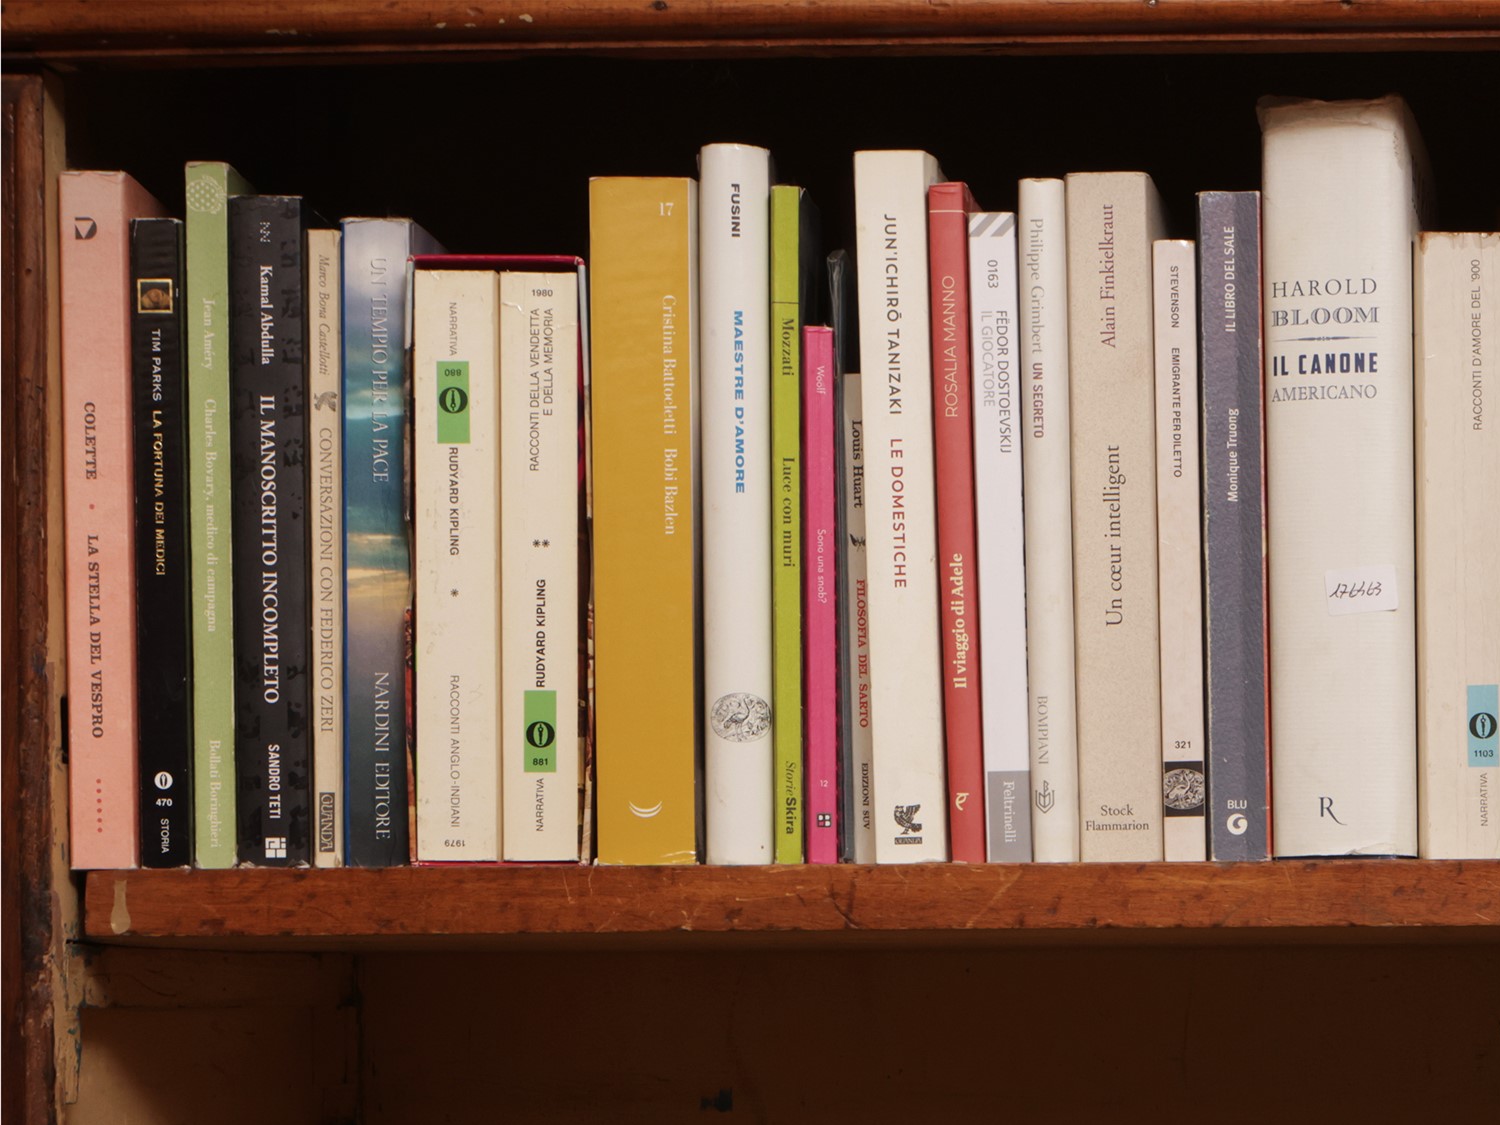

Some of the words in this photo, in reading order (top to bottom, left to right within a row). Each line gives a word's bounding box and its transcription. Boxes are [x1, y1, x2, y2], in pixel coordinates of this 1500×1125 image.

[731, 184, 740, 237] FUSINI
[260, 265, 273, 308] Kamal
[987, 260, 999, 288] 0163
[1272, 279, 1377, 298] HAROLD
[1170, 266, 1179, 328] STEVENSON
[1272, 307, 1380, 327] BLOOM
[152, 329, 161, 351] TIM
[261, 312, 273, 364] Abdulla
[663, 295, 675, 354] Cristina
[996, 311, 1010, 356] FËDOR
[735, 311, 744, 400] MAESTRE
[888, 329, 901, 414] TANIZAKI
[1172, 348, 1180, 408] EMIGRANTE
[1274, 356, 1289, 376] IL
[1299, 353, 1378, 374] CANONE
[152, 357, 162, 401] PARKS
[664, 359, 677, 434] Battocletti
[1272, 384, 1377, 402] AMERICANO
[153, 410, 162, 428] LA
[260, 396, 275, 415] IL
[998, 361, 1012, 453] DOSTOEVSKIJ
[1173, 411, 1181, 431] PER
[84, 402, 97, 479] COLETTE
[891, 439, 903, 458] LE
[1173, 434, 1182, 477] DILETTO
[153, 433, 163, 497] FORTUNA
[782, 457, 796, 492] Luce
[155, 502, 164, 524] DEI
[260, 420, 278, 566] MANOSCRITTO
[320, 428, 332, 560] CONVERSAZIONI
[783, 498, 792, 524] con
[1102, 445, 1126, 538] intelligent
[88, 535, 98, 556] LA
[783, 530, 795, 567] muri
[891, 466, 906, 588] DOMESTICHE
[155, 529, 165, 575] MEDICI
[1110, 545, 1121, 592] cœur
[88, 562, 100, 626] STELLA
[320, 567, 333, 601] CON
[1106, 599, 1123, 626] Un
[90, 632, 101, 664] DEL
[262, 572, 279, 703] INCOMPLETO
[321, 608, 333, 689] FEDERICO
[91, 670, 103, 738] VESPRO
[321, 696, 333, 732] ZERI
[450, 675, 460, 734] RACCONTI
[268, 744, 280, 790] SANDRO
[450, 739, 461, 827] ANGLO-INDIANI
[269, 795, 281, 818] TETI
